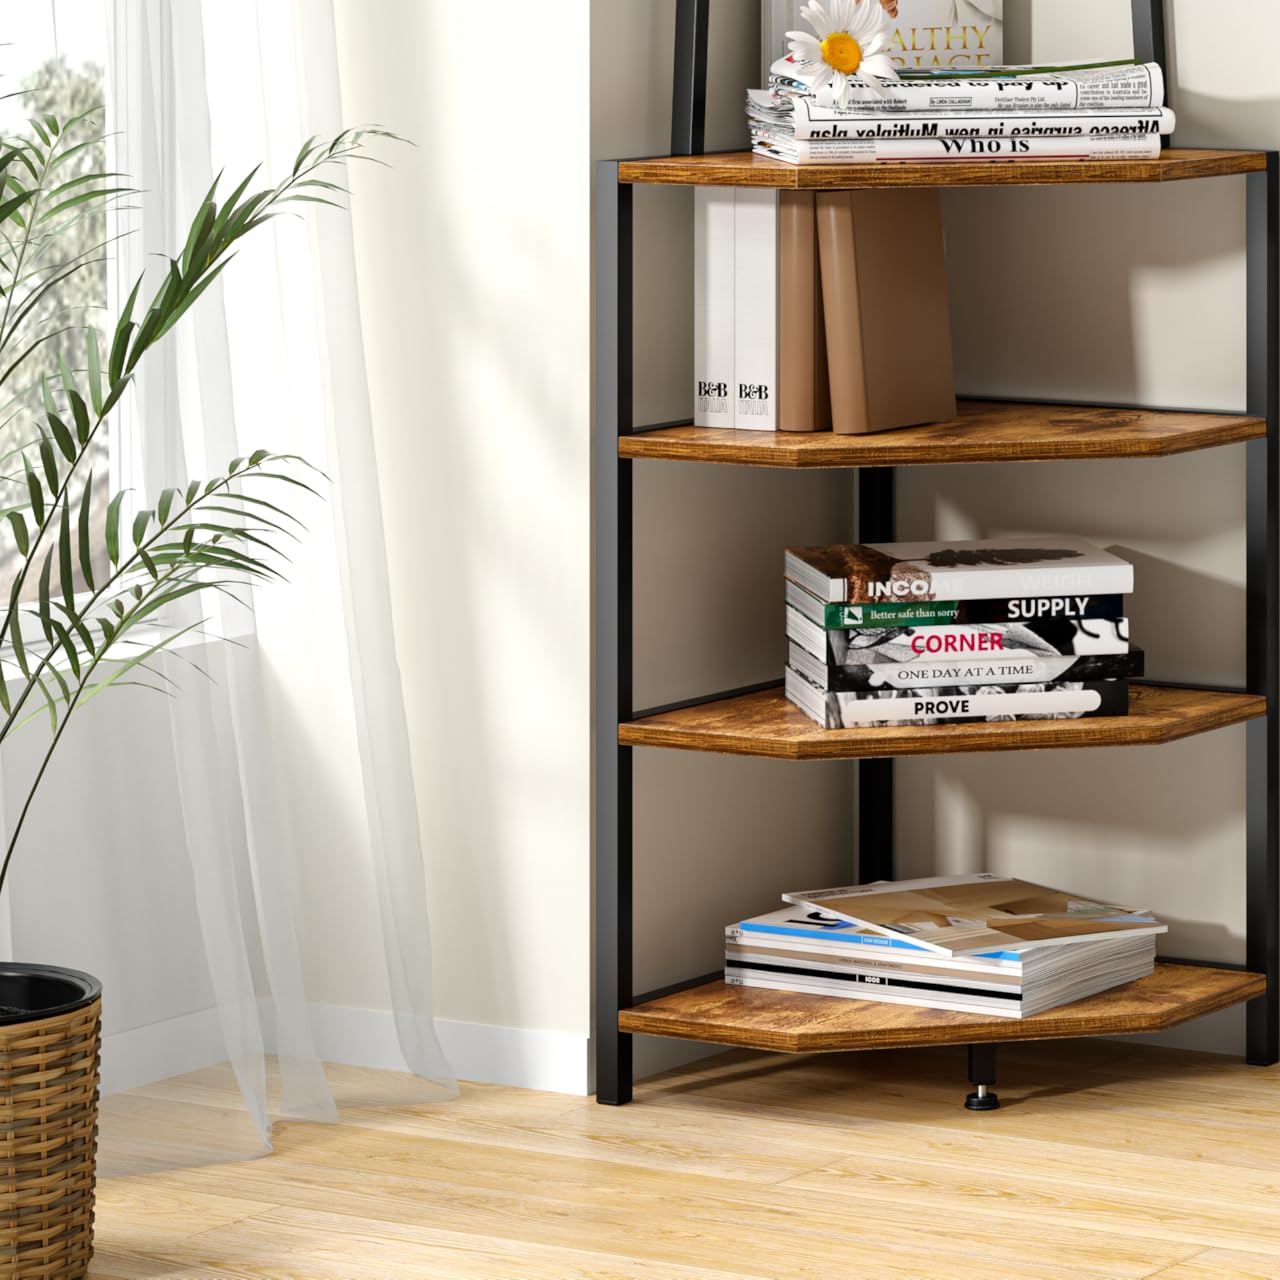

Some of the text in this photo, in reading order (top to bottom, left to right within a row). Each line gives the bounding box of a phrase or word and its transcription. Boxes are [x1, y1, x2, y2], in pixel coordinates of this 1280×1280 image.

[884, 25, 991, 52] ALTHY
[938, 138, 1030, 153] Who is
[698, 381, 728, 397] B&B
[739, 384, 769, 400] B&B
[870, 597, 1090, 620] Better safe than sorry SUPPLY
[911, 632, 1005, 654] CORNER
[898, 665, 1033, 680] ONE DAY AT A TIME
[914, 700, 970, 715] PROVE
